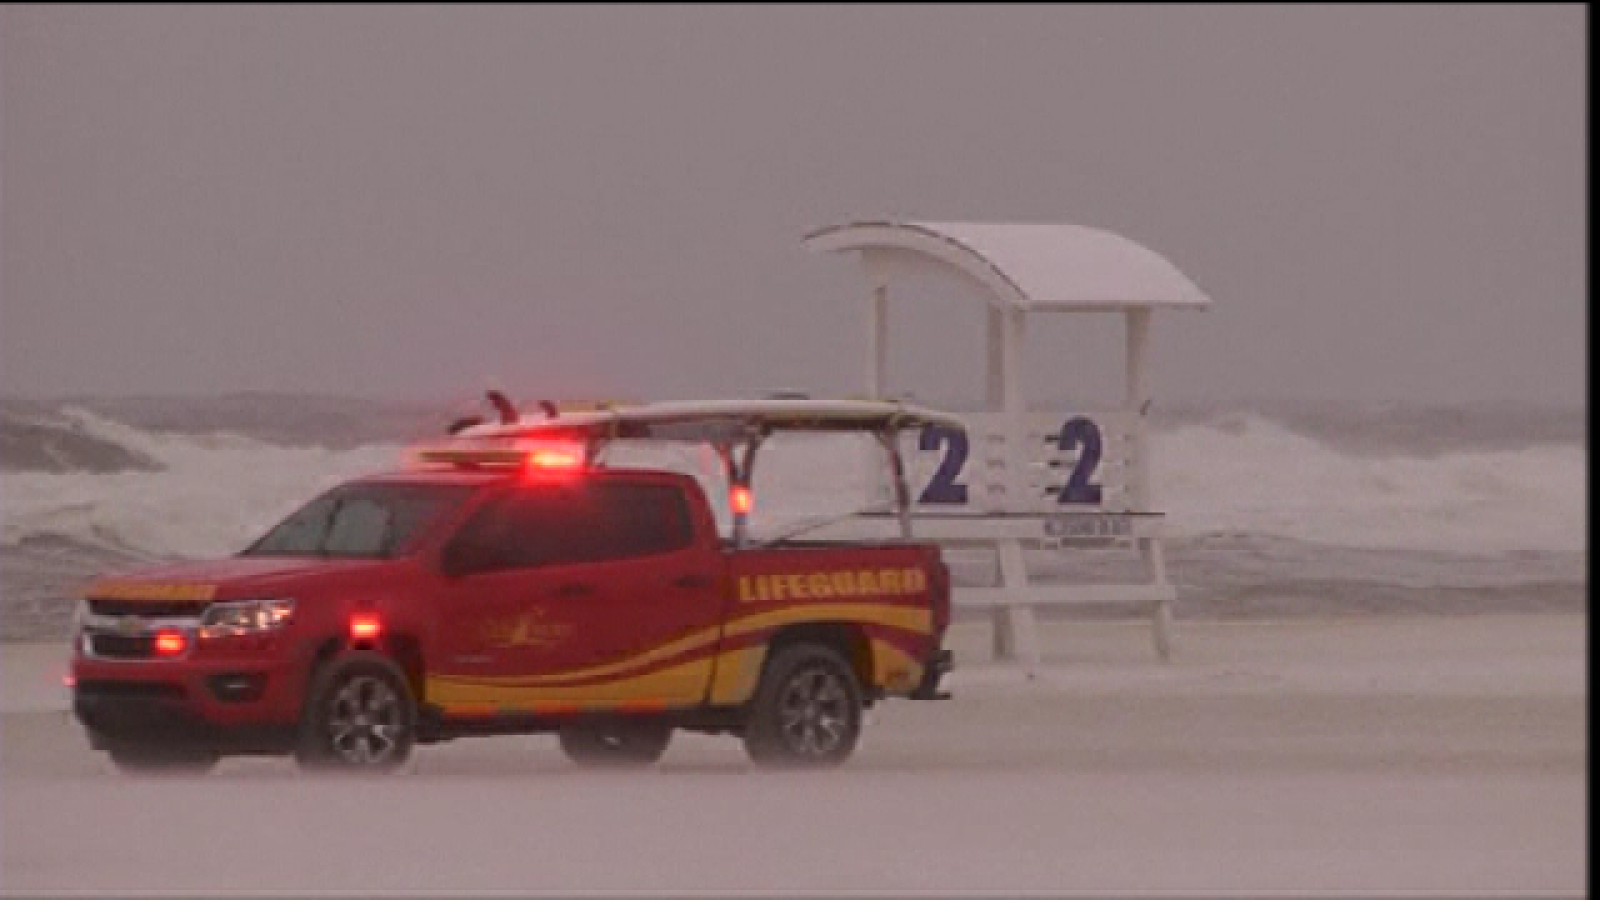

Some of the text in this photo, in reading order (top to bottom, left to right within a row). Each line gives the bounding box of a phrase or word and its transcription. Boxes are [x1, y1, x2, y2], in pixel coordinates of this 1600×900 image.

[917, 421, 969, 505] 2
[1057, 416, 1102, 505] 2
[738, 569, 926, 601] LIFEGUARD
